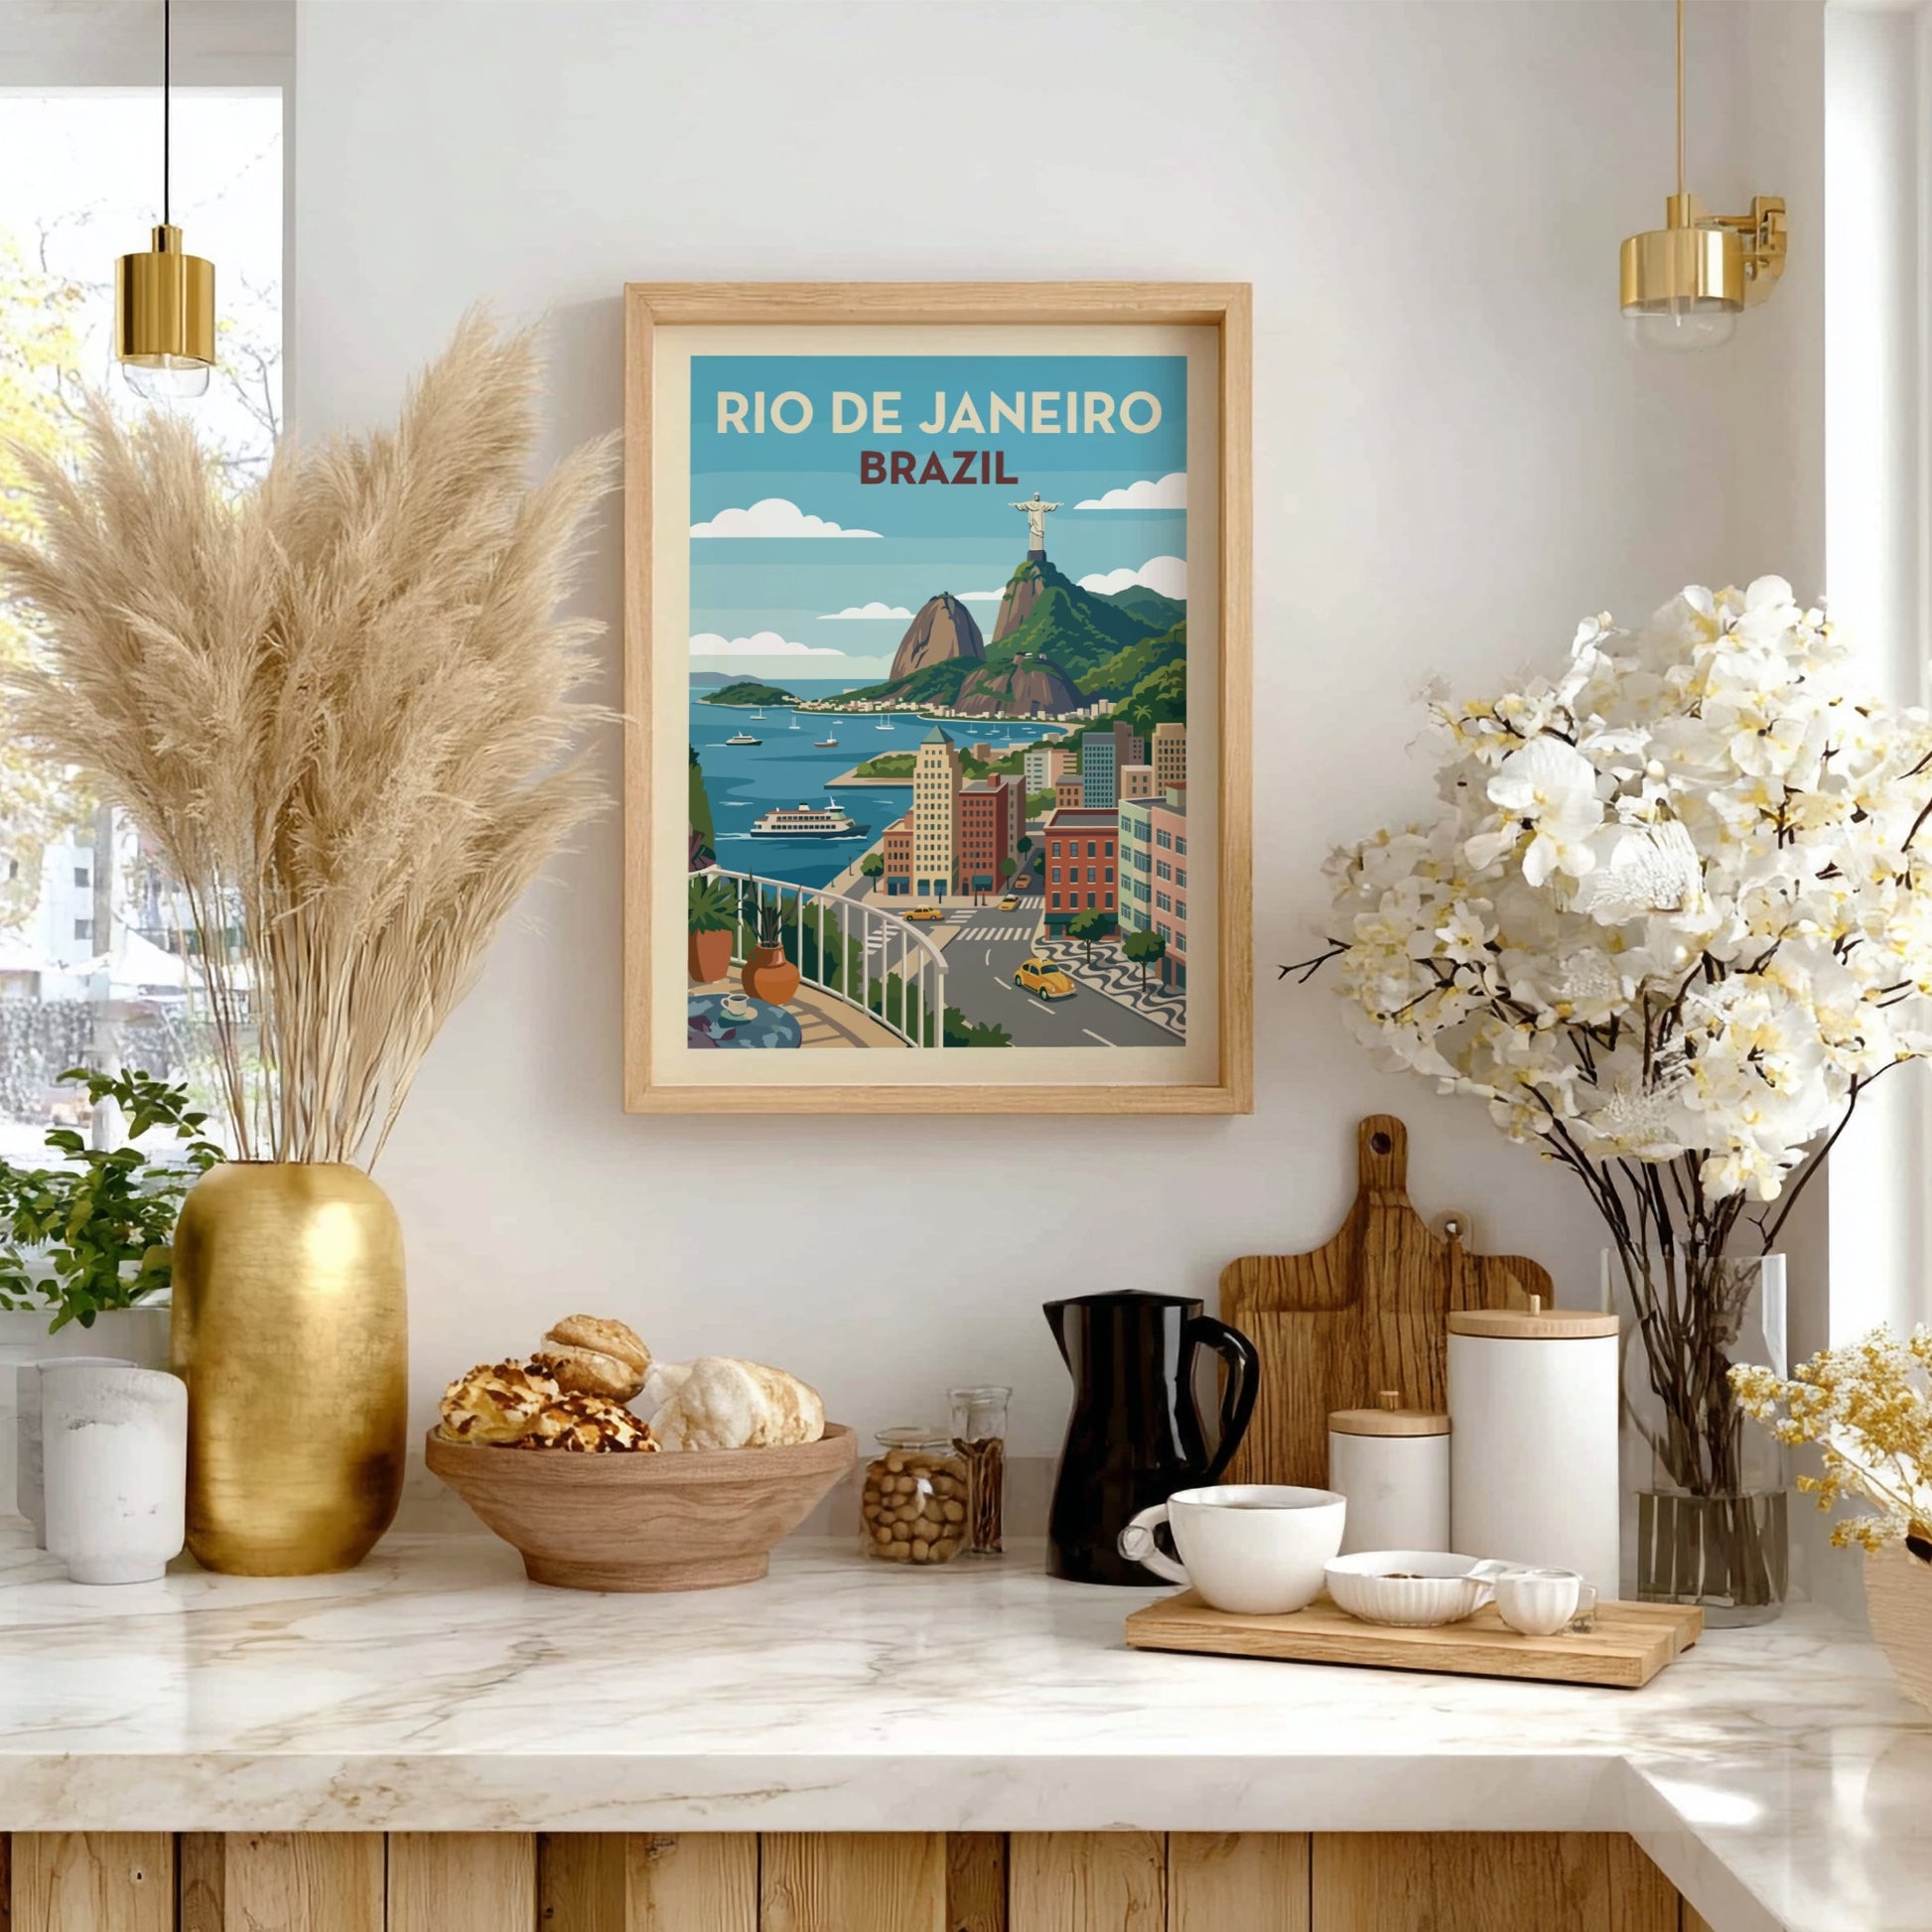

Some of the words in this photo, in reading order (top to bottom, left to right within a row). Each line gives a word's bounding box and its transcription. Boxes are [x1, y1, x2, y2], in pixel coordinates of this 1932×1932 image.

[717, 390, 813, 433] RIO
[832, 391, 902, 433] DE
[918, 390, 1163, 433] JANEIRO
[860, 451, 1019, 484] BRAZIL
